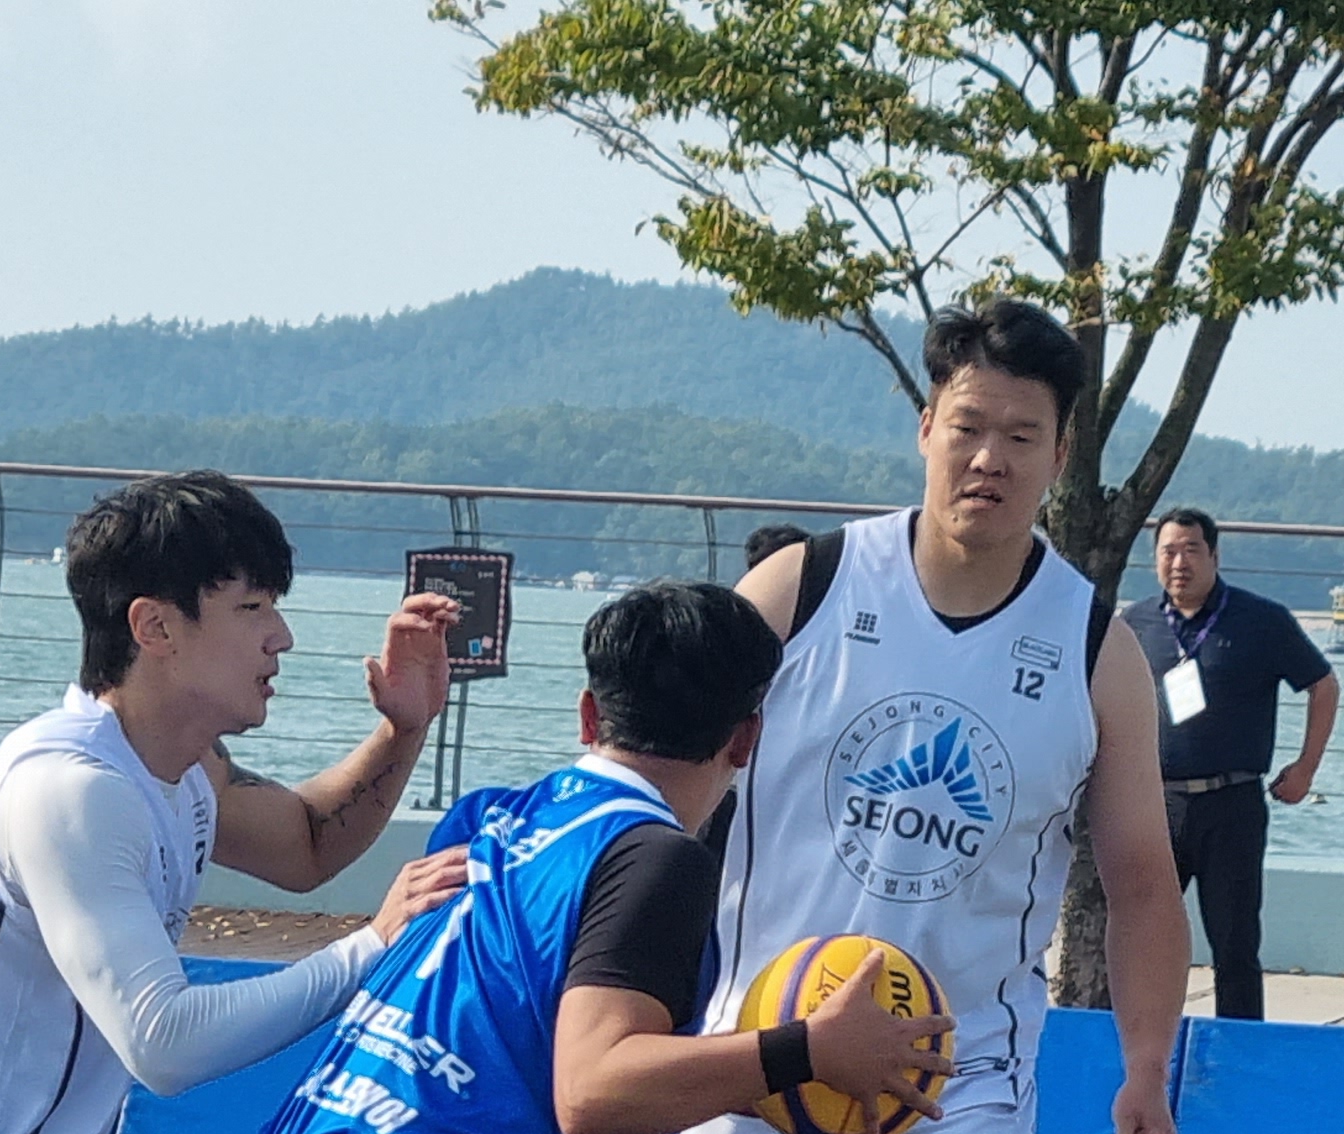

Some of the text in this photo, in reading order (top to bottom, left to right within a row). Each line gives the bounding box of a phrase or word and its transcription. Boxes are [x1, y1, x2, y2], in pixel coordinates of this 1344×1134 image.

[1012, 667, 1046, 701] 12
[839, 700, 1007, 796] SEJONG CITY
[842, 795, 985, 858] SEJONG
